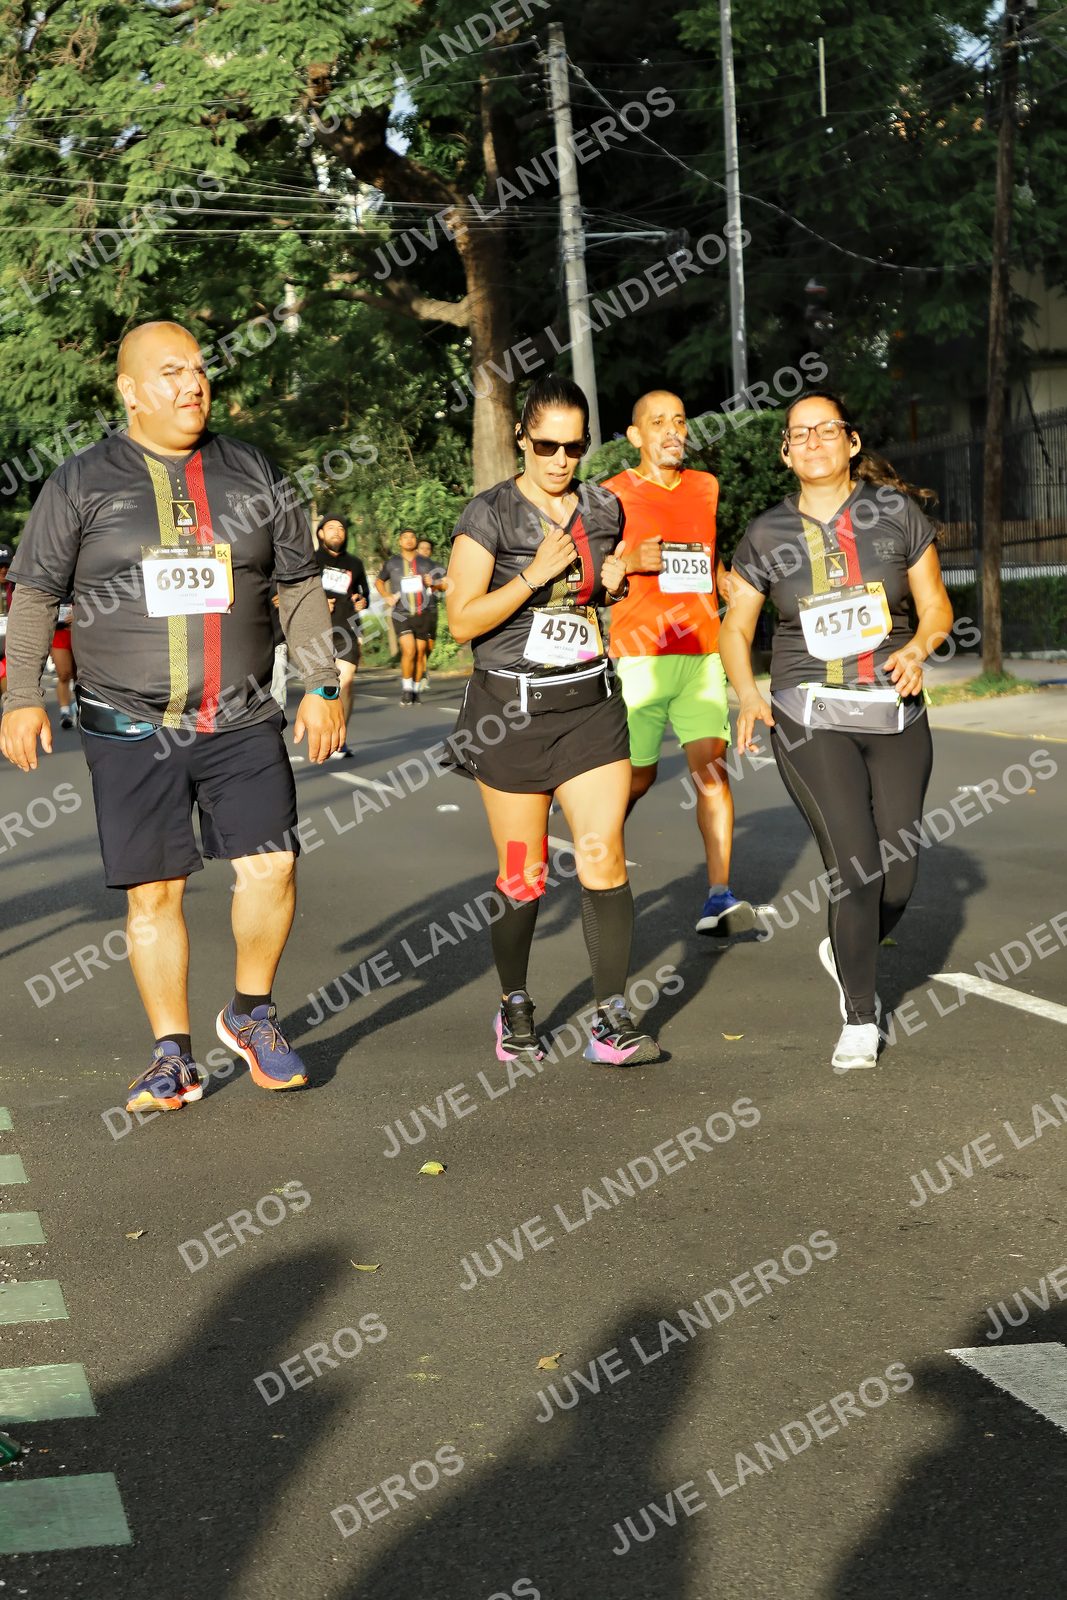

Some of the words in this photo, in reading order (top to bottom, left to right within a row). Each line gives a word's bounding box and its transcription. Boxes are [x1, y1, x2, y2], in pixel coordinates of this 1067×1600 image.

[156, 567, 215, 591] 6939
[664, 558, 708, 575] 10258
[541, 618, 589, 646] 4579
[814, 605, 871, 637] 4576
